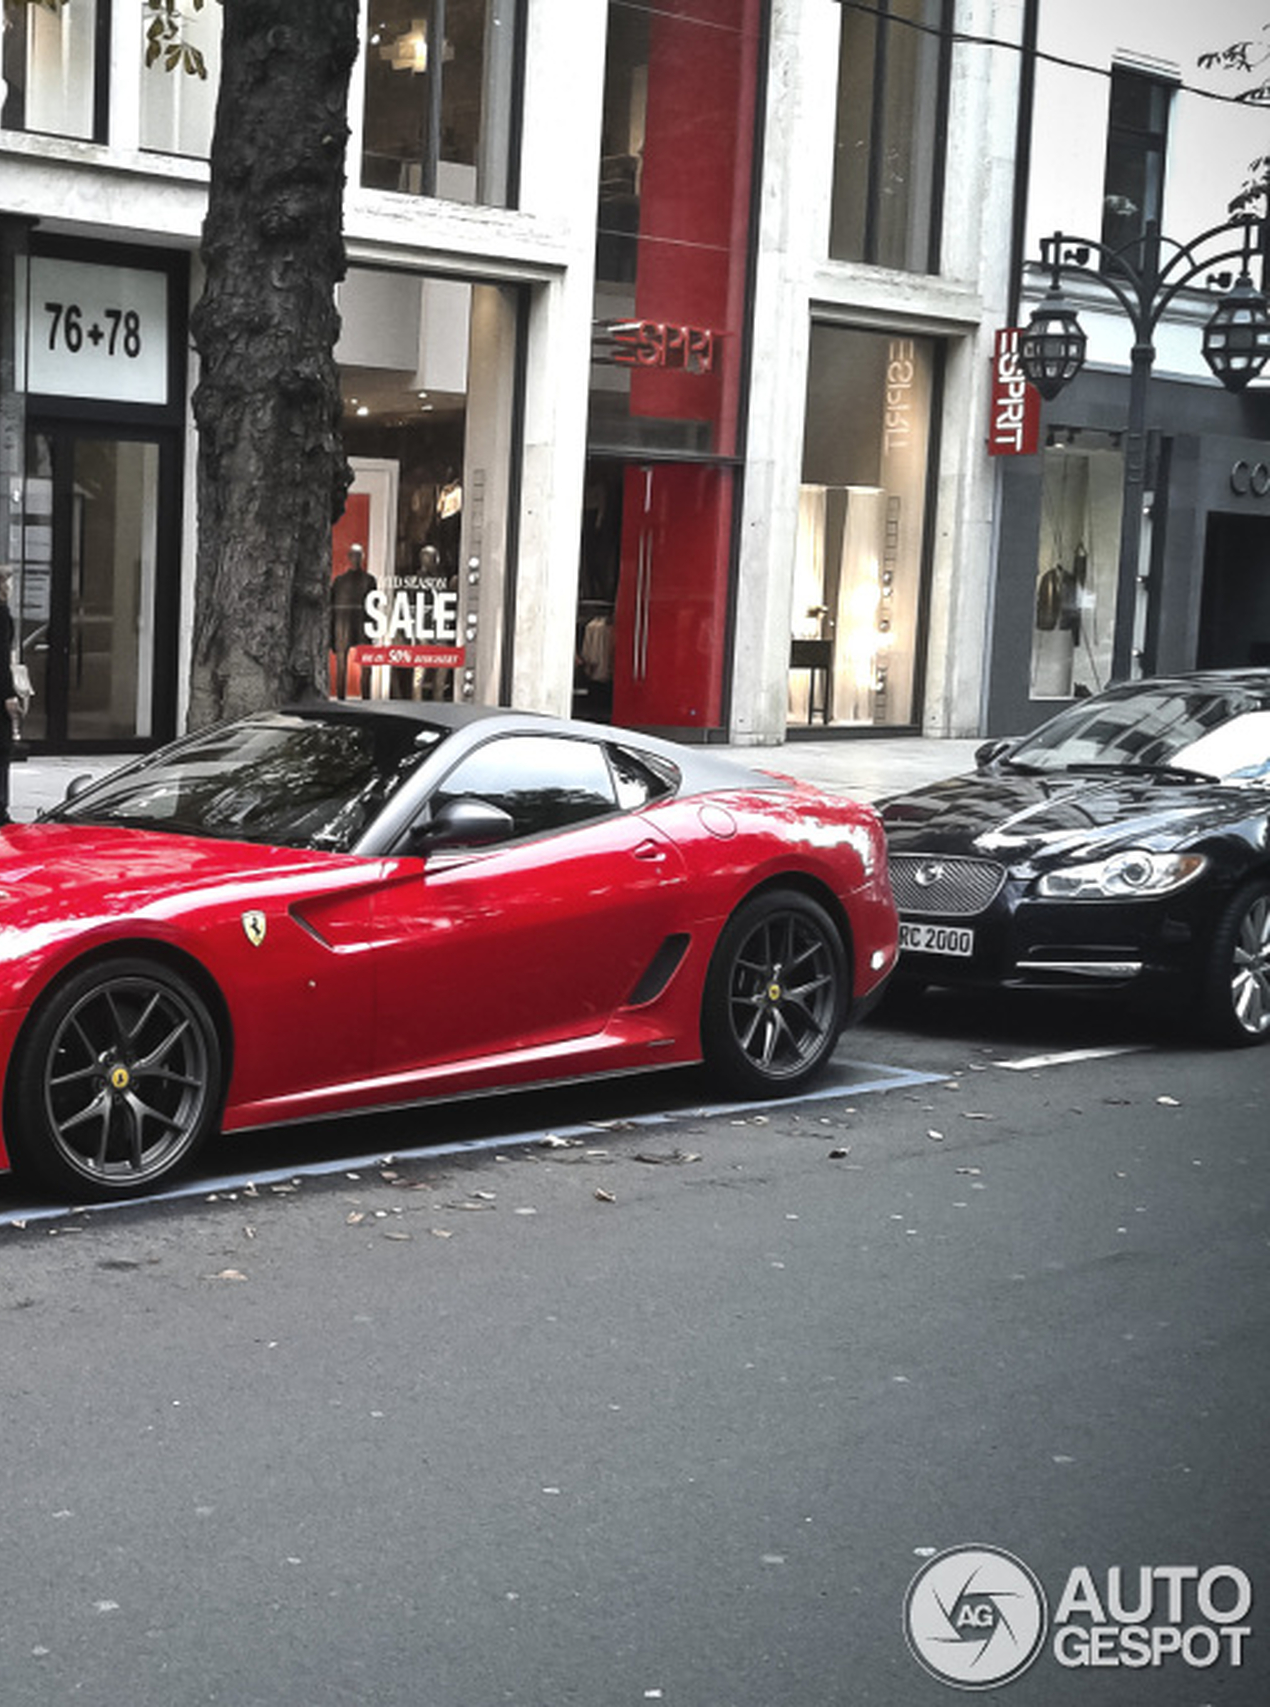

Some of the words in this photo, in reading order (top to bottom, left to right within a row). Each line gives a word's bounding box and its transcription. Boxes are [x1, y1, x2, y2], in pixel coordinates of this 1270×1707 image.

[44, 302, 141, 358] 76+78
[364, 589, 458, 640] SALE
[925, 928, 970, 953] 2000
